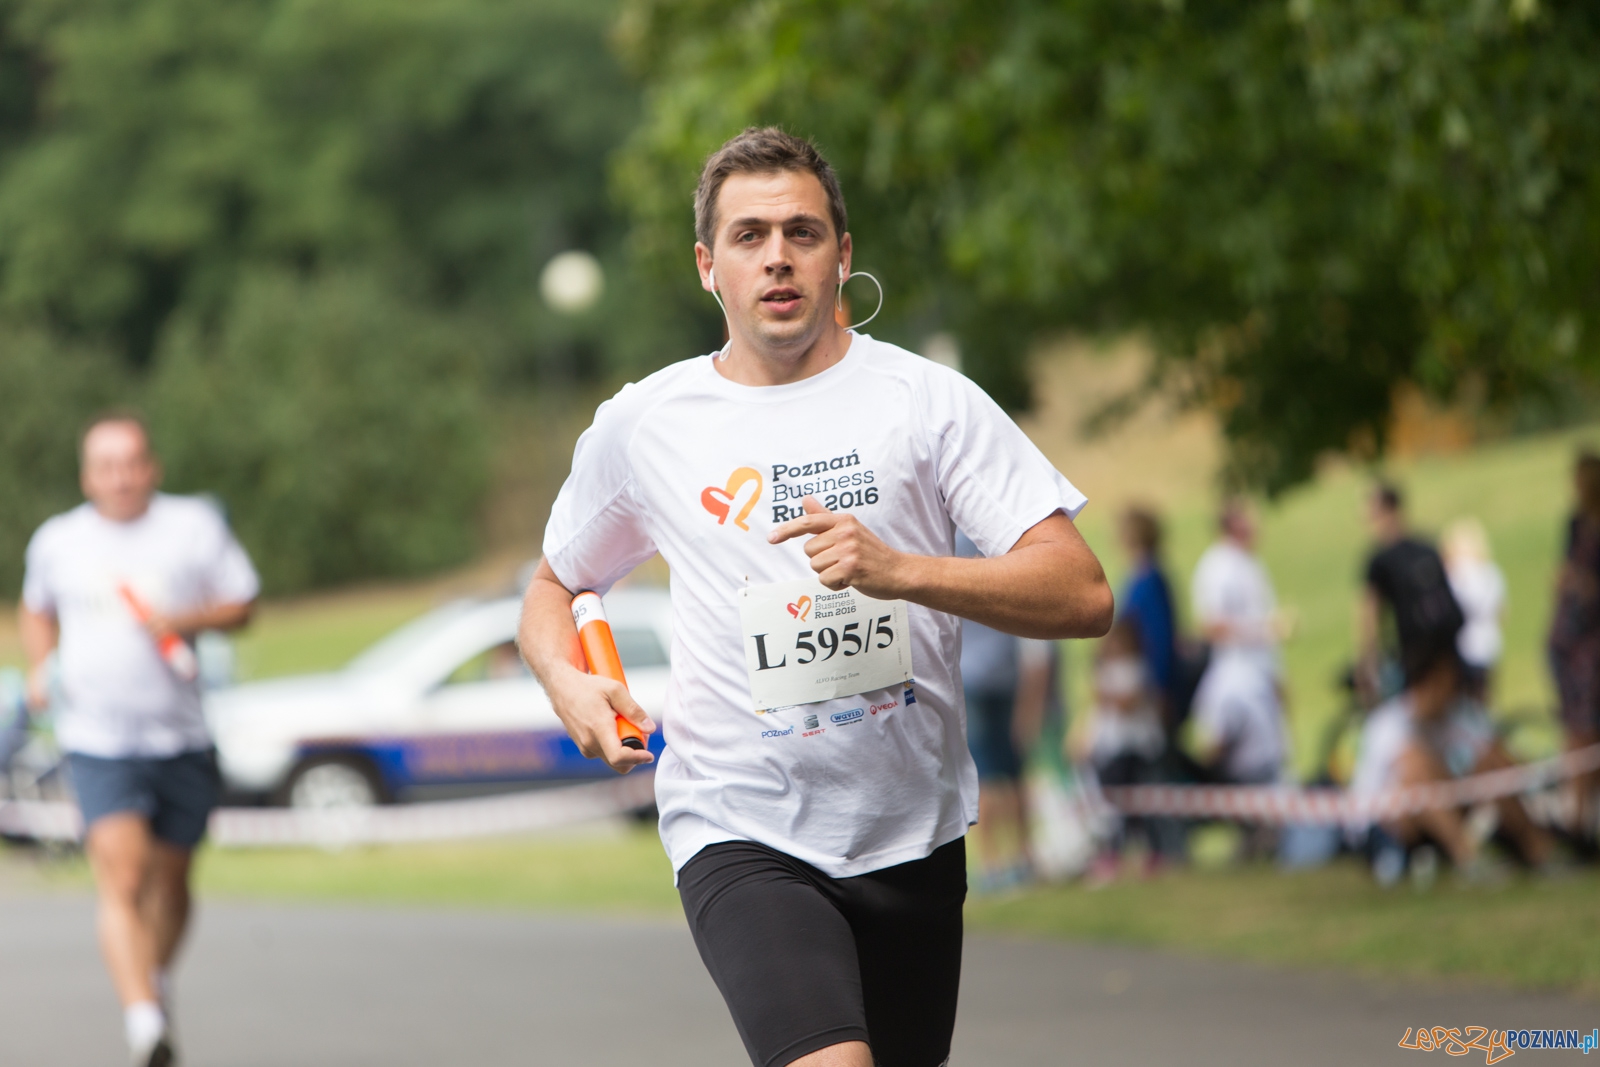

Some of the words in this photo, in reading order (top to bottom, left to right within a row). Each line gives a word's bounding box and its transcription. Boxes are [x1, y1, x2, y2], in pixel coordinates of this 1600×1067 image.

[772, 448, 861, 482] Poznań
[772, 470, 875, 503] Business
[772, 504, 804, 523] Ru
[825, 487, 879, 512] 2016
[814, 598, 856, 611] Business
[815, 590, 851, 603] Poznań
[814, 610, 834, 619] Run
[835, 605, 857, 616] 2016
[751, 633, 786, 671] L
[795, 614, 894, 665] 595/5
[802, 728, 826, 738] SEAT
